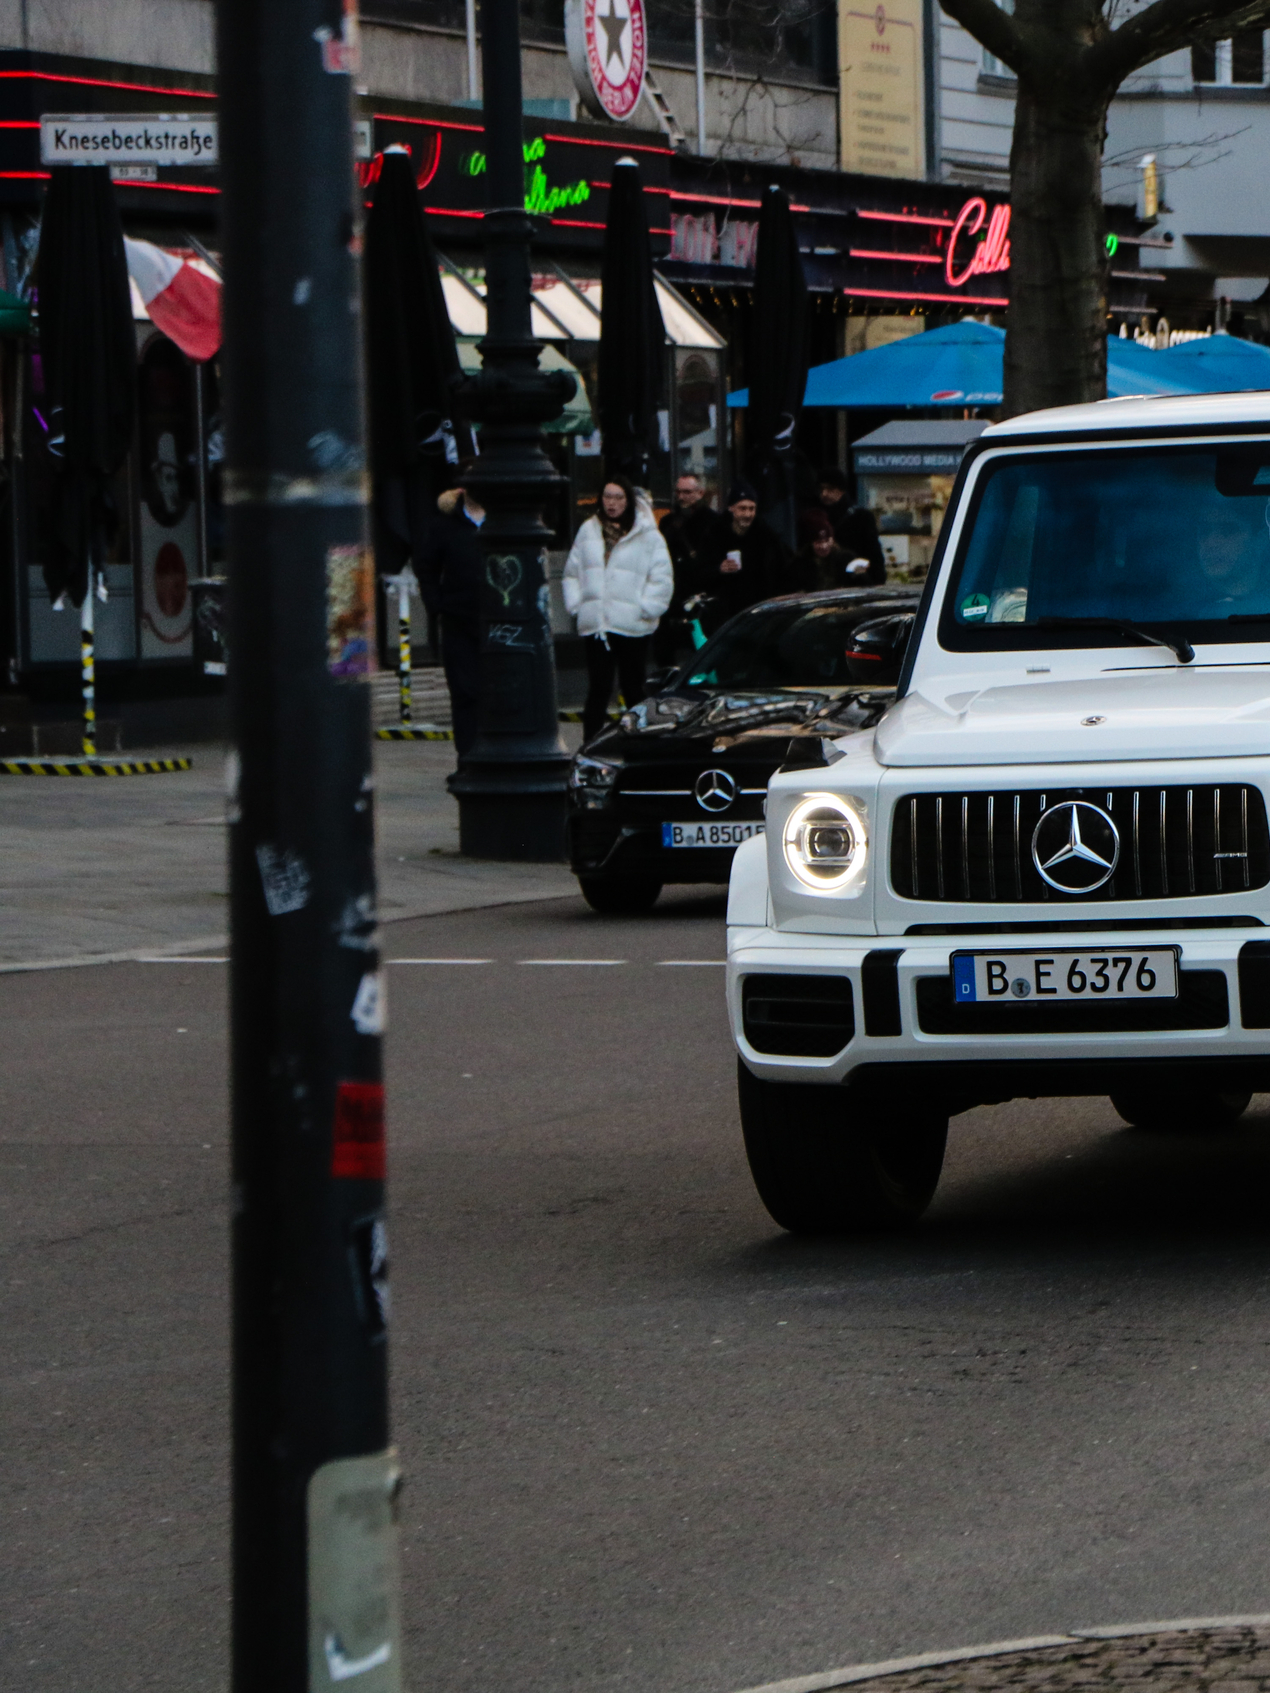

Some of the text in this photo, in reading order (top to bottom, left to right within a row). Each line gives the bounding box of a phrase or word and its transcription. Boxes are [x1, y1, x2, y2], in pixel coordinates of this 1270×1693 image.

[55, 129, 213, 155] Knesebeckstraße
[858, 454, 921, 467] HOLLYWOOD
[971, 594, 980, 607] 4
[673, 826, 684, 844] B
[696, 825, 706, 844] A
[986, 960, 1010, 996] B
[1034, 959, 1058, 995] E
[1067, 956, 1157, 994] 6376
